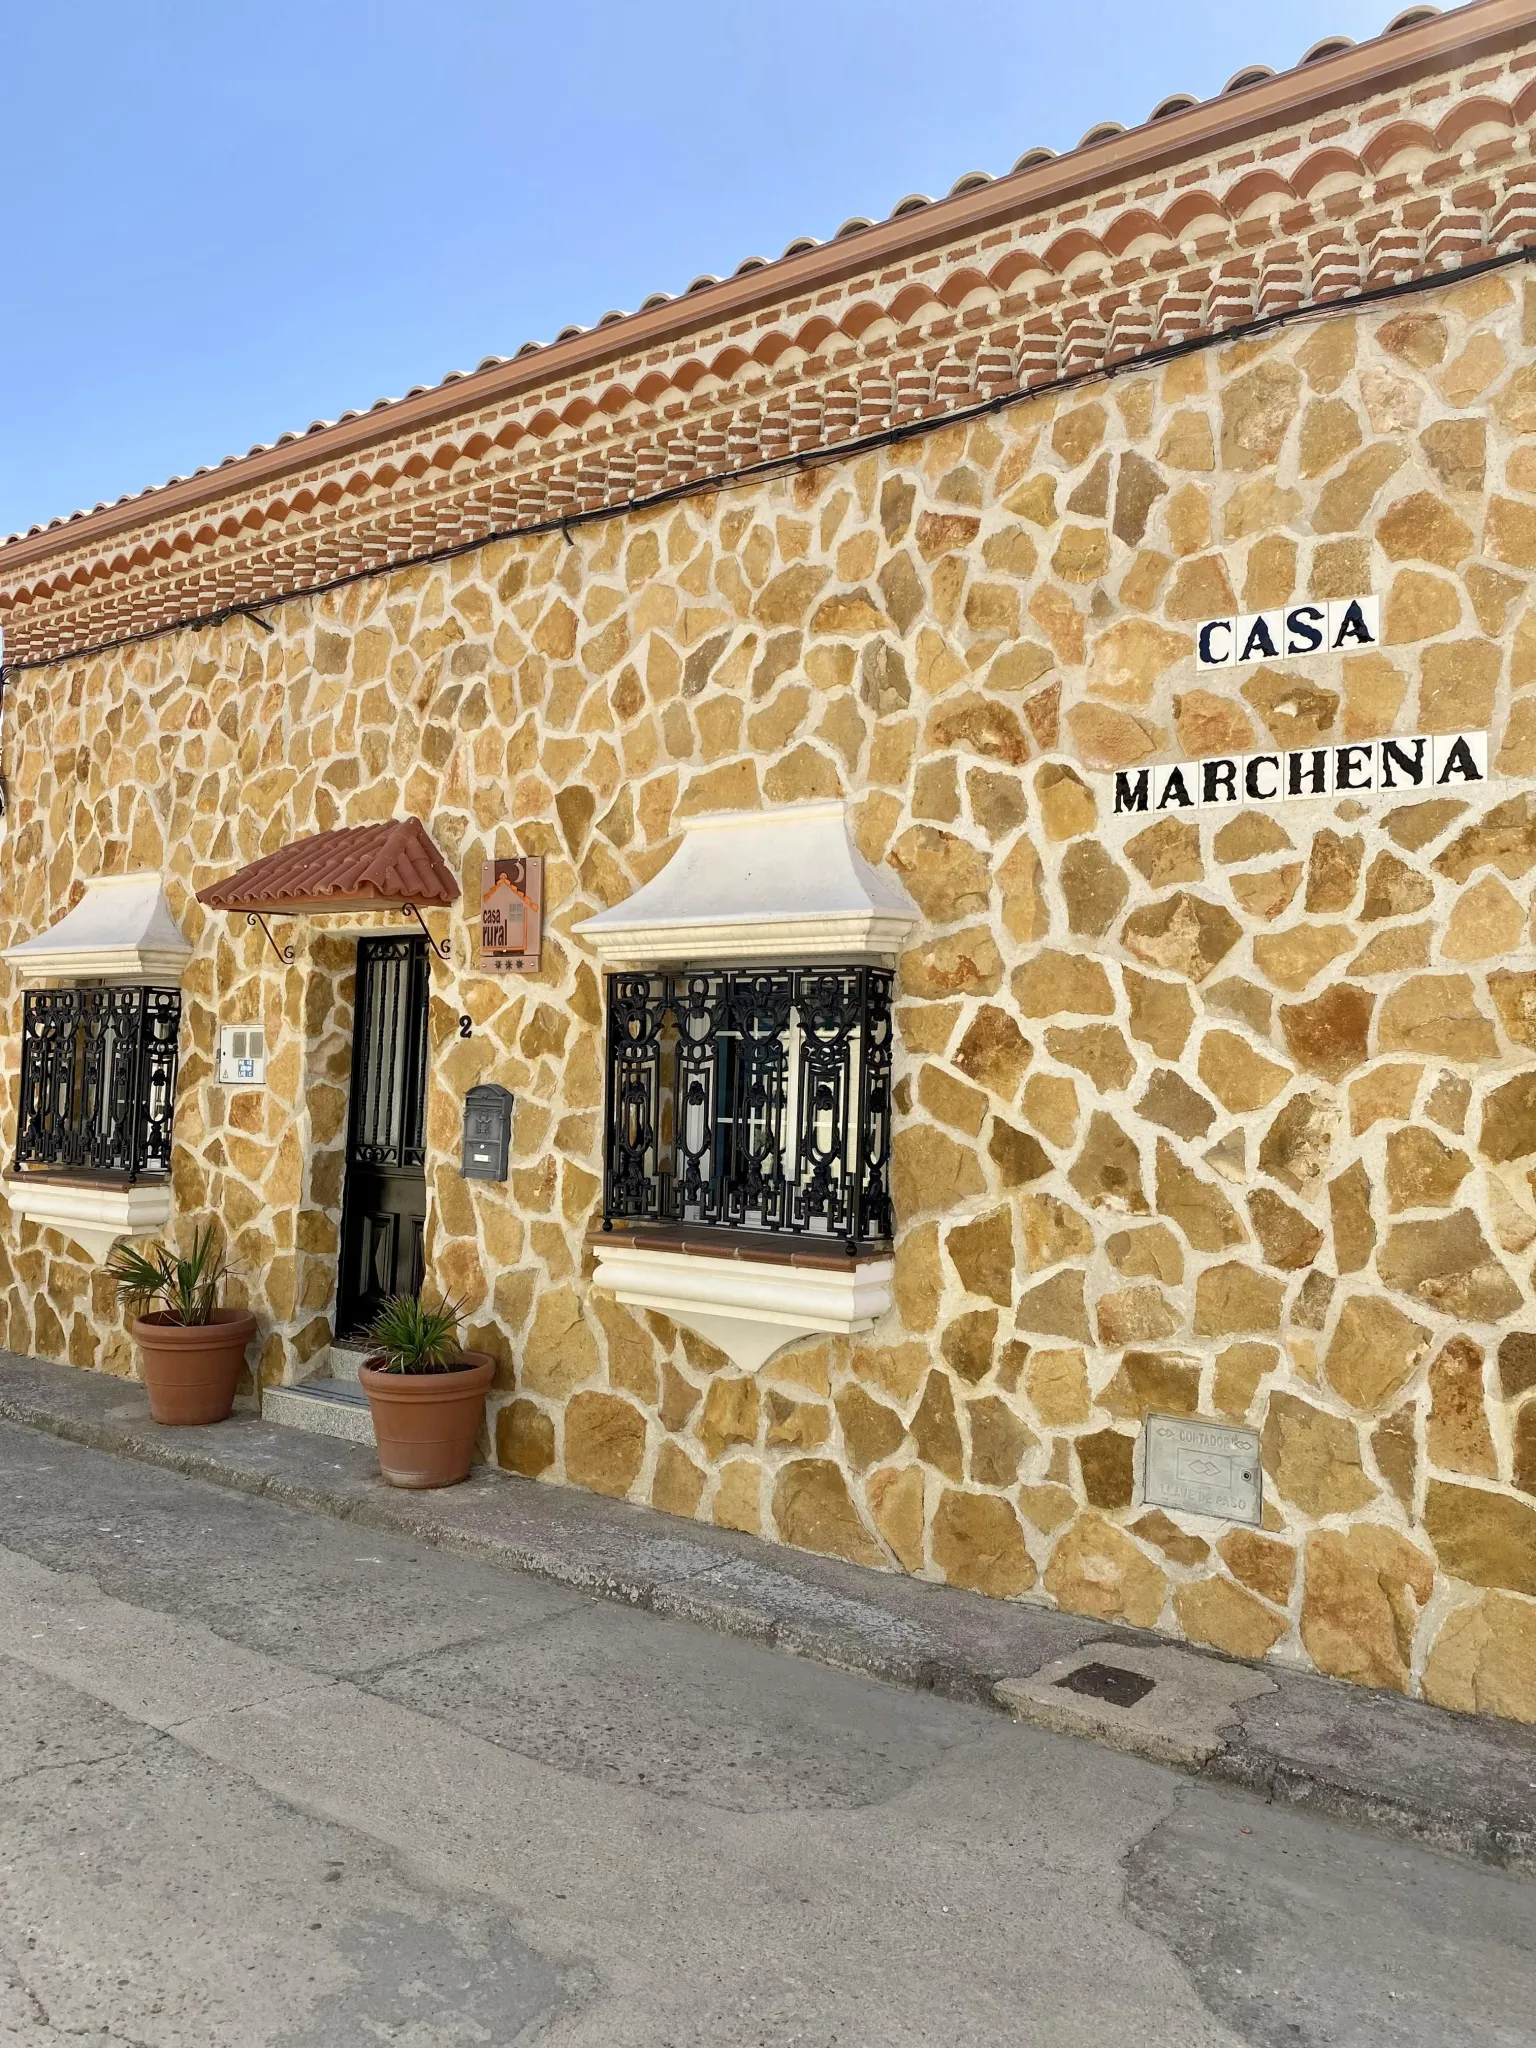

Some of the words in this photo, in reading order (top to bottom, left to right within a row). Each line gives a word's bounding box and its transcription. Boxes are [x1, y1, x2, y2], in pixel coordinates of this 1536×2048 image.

[1199, 599, 1376, 665] CASA
[1113, 735, 1484, 814] MARCHENA
[483, 909, 501, 924] casa
[482, 918, 508, 947] rural
[459, 1014, 473, 1039] 2
[1179, 1429, 1230, 1450] CONTADOR
[1160, 1483, 1195, 1501] LLAVE
[1198, 1489, 1213, 1504] DE
[1216, 1495, 1247, 1510] PASO
